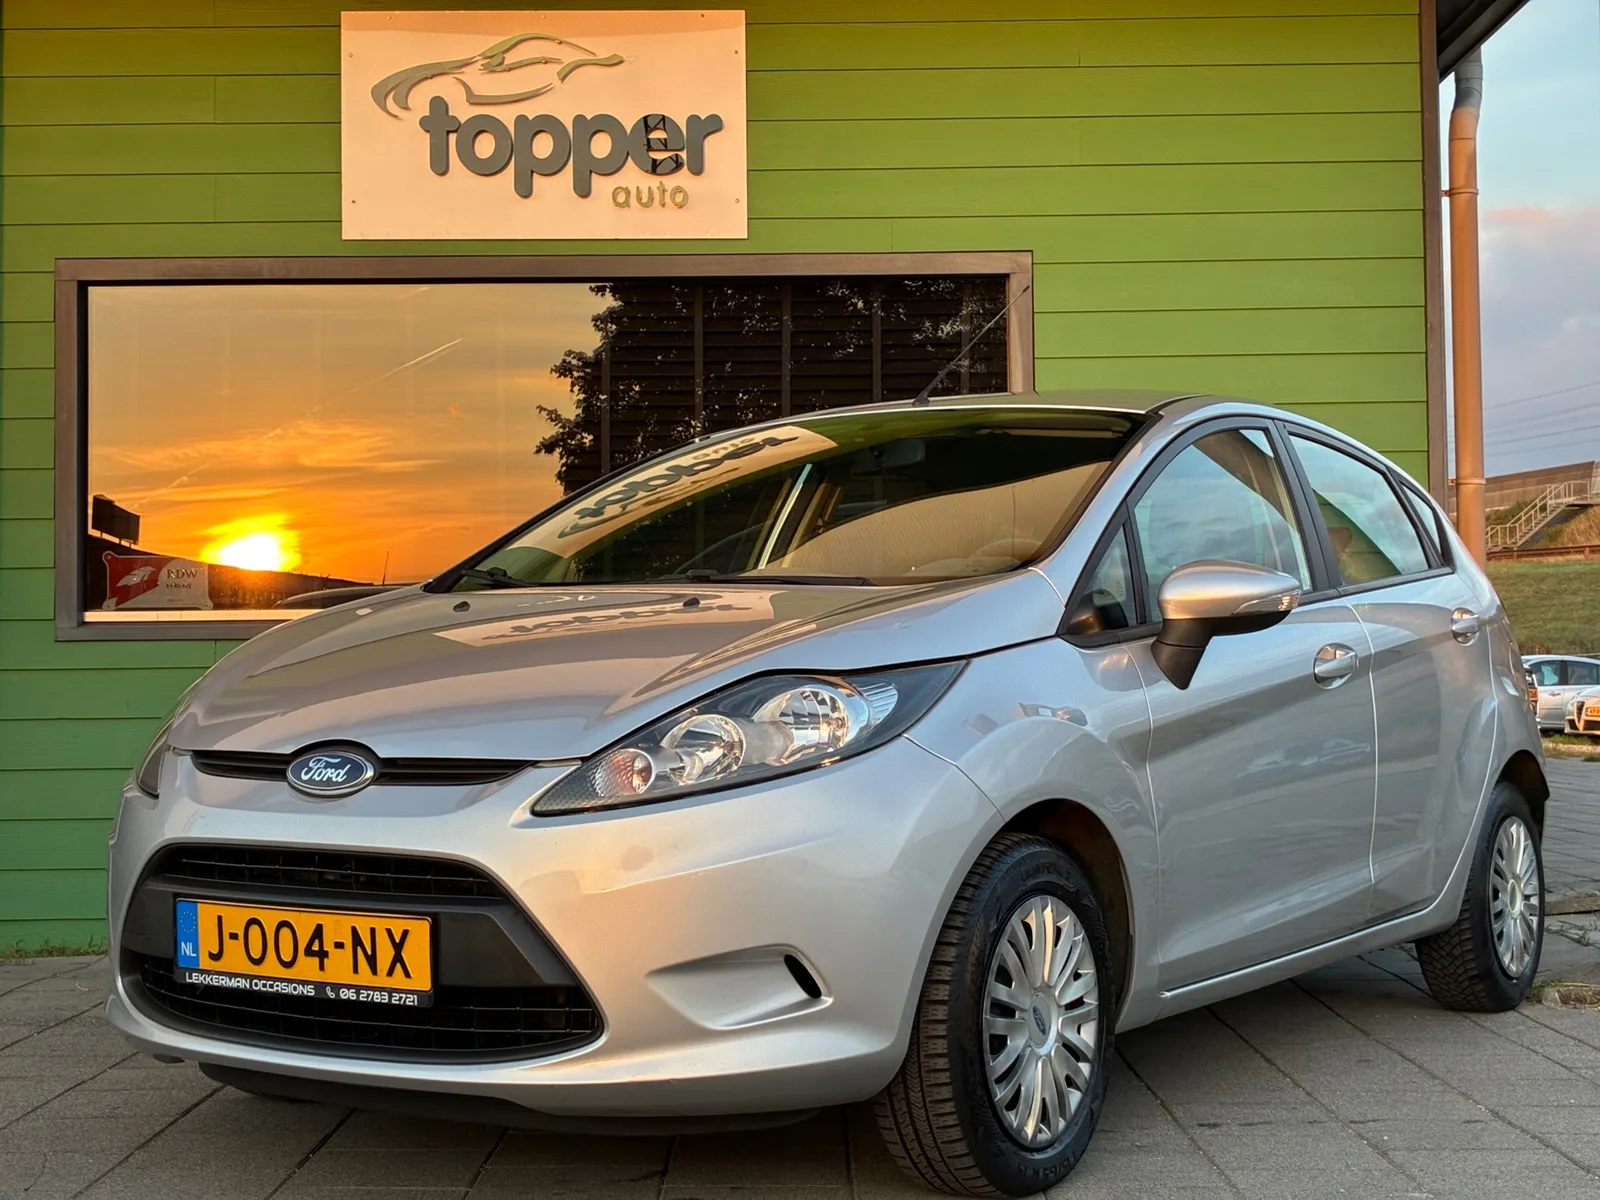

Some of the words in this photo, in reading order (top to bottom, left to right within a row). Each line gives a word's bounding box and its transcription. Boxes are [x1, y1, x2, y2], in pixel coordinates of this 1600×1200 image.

[419, 95, 724, 199] topper
[611, 180, 690, 209] auto
[166, 568, 198, 579] RDW
[301, 756, 352, 782] Ford
[181, 941, 197, 957] NL
[208, 914, 413, 979] J-004-NX
[185, 972, 250, 989] LEKKERMAN
[252, 979, 315, 996] OCCASIONS
[339, 988, 357, 1000] 06
[359, 989, 389, 1003] 2783
[391, 992, 418, 1006] 2721
